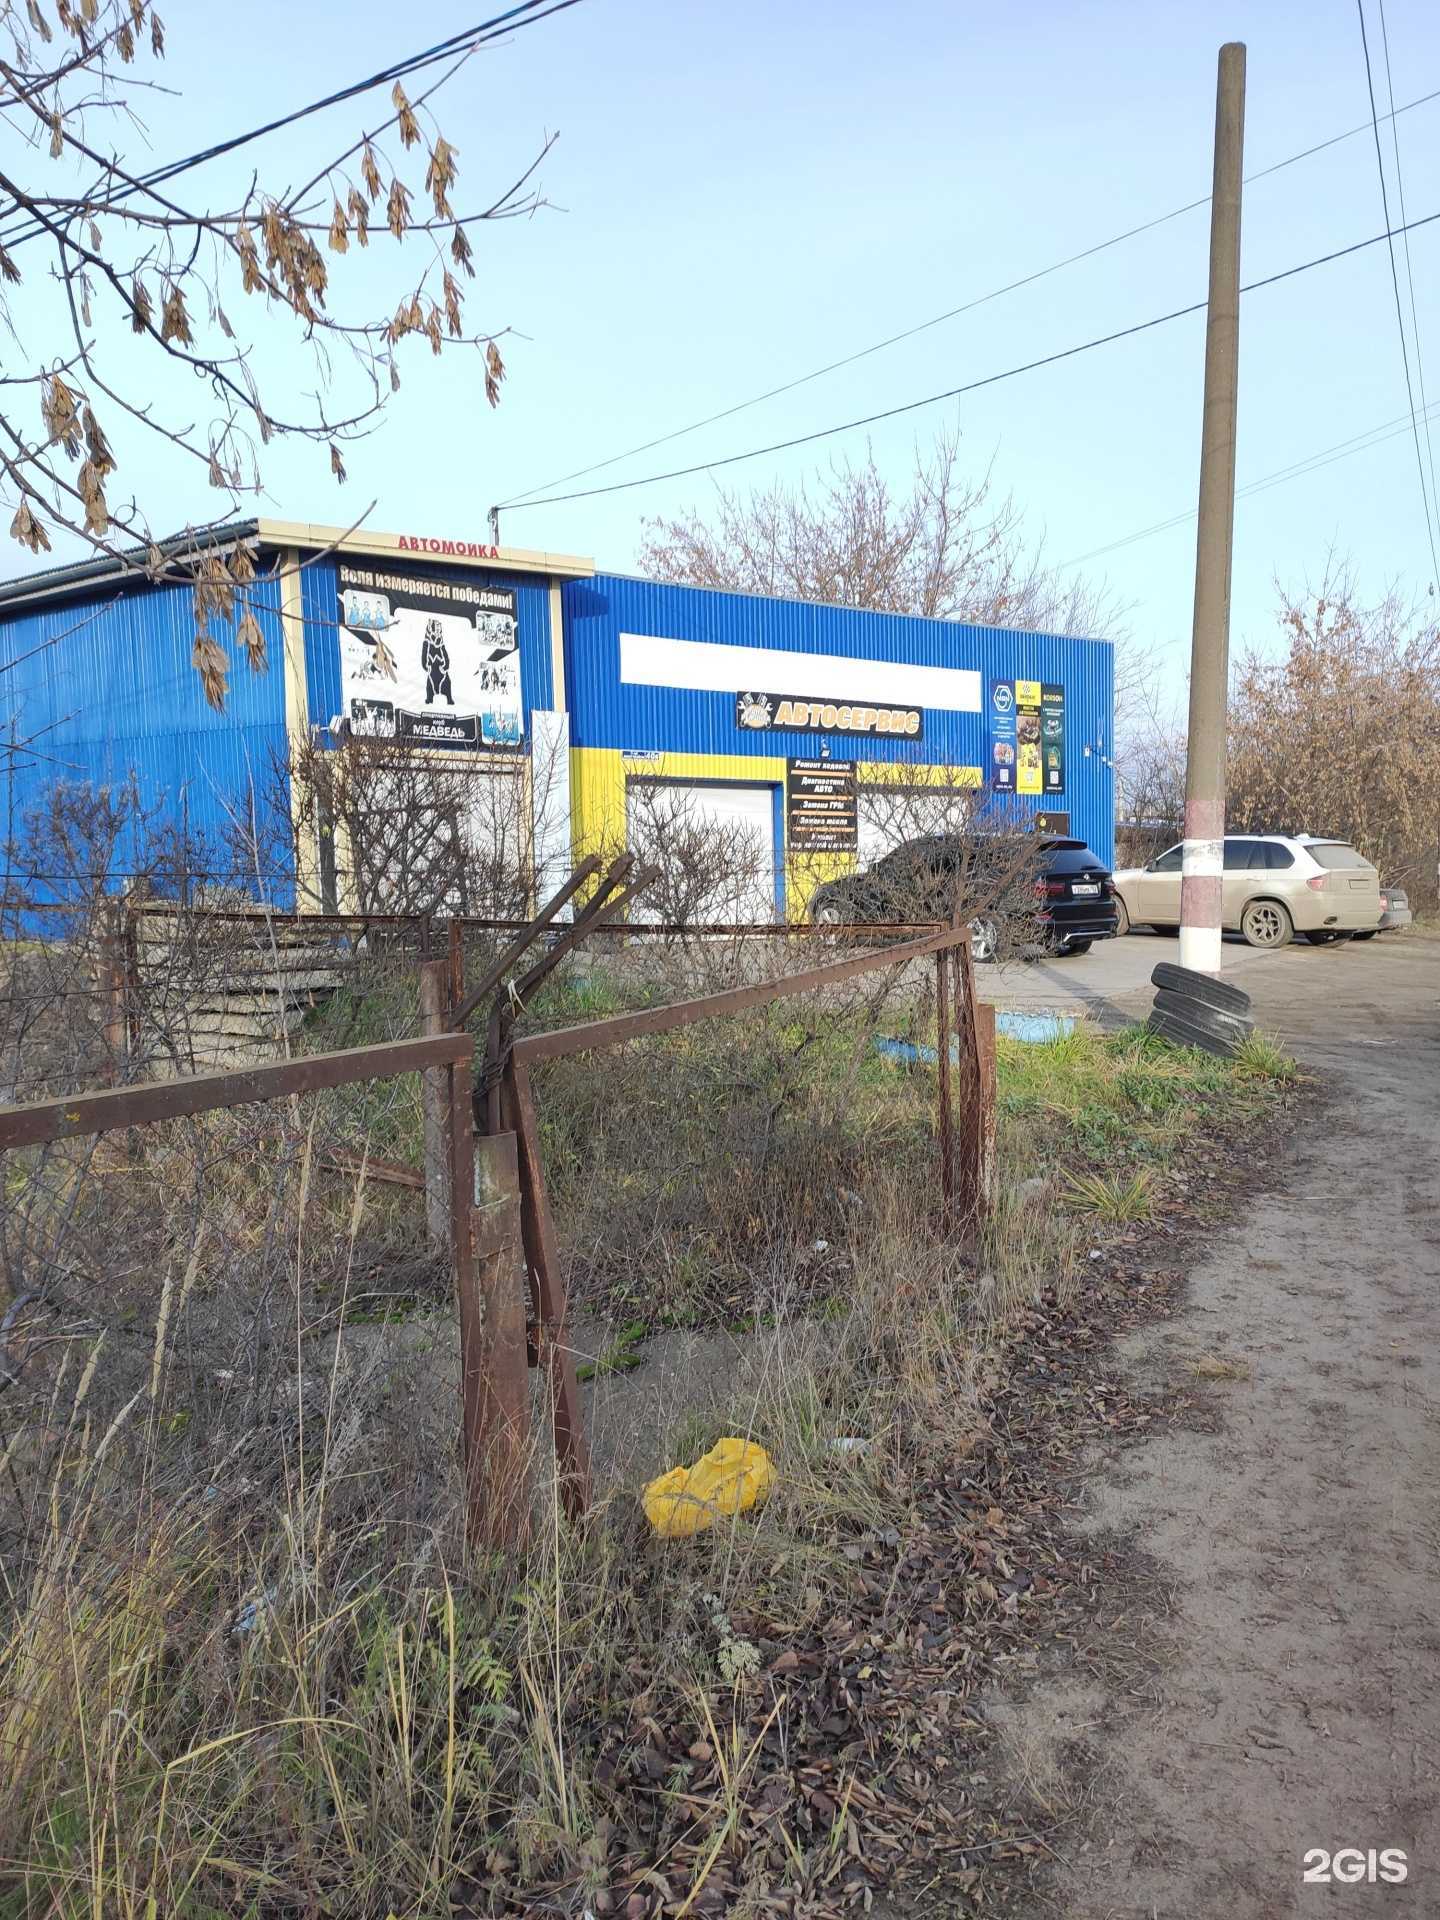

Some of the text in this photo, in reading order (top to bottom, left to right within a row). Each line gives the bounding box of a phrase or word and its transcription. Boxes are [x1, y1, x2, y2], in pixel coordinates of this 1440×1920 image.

[375, 572, 451, 600] измеряется
[452, 586, 513, 609] победами!
[773, 701, 920, 735] АВТОСЕРВИС
[412, 724, 466, 739] МЕДВЕДЬ
[814, 785, 834, 793] АВТО
